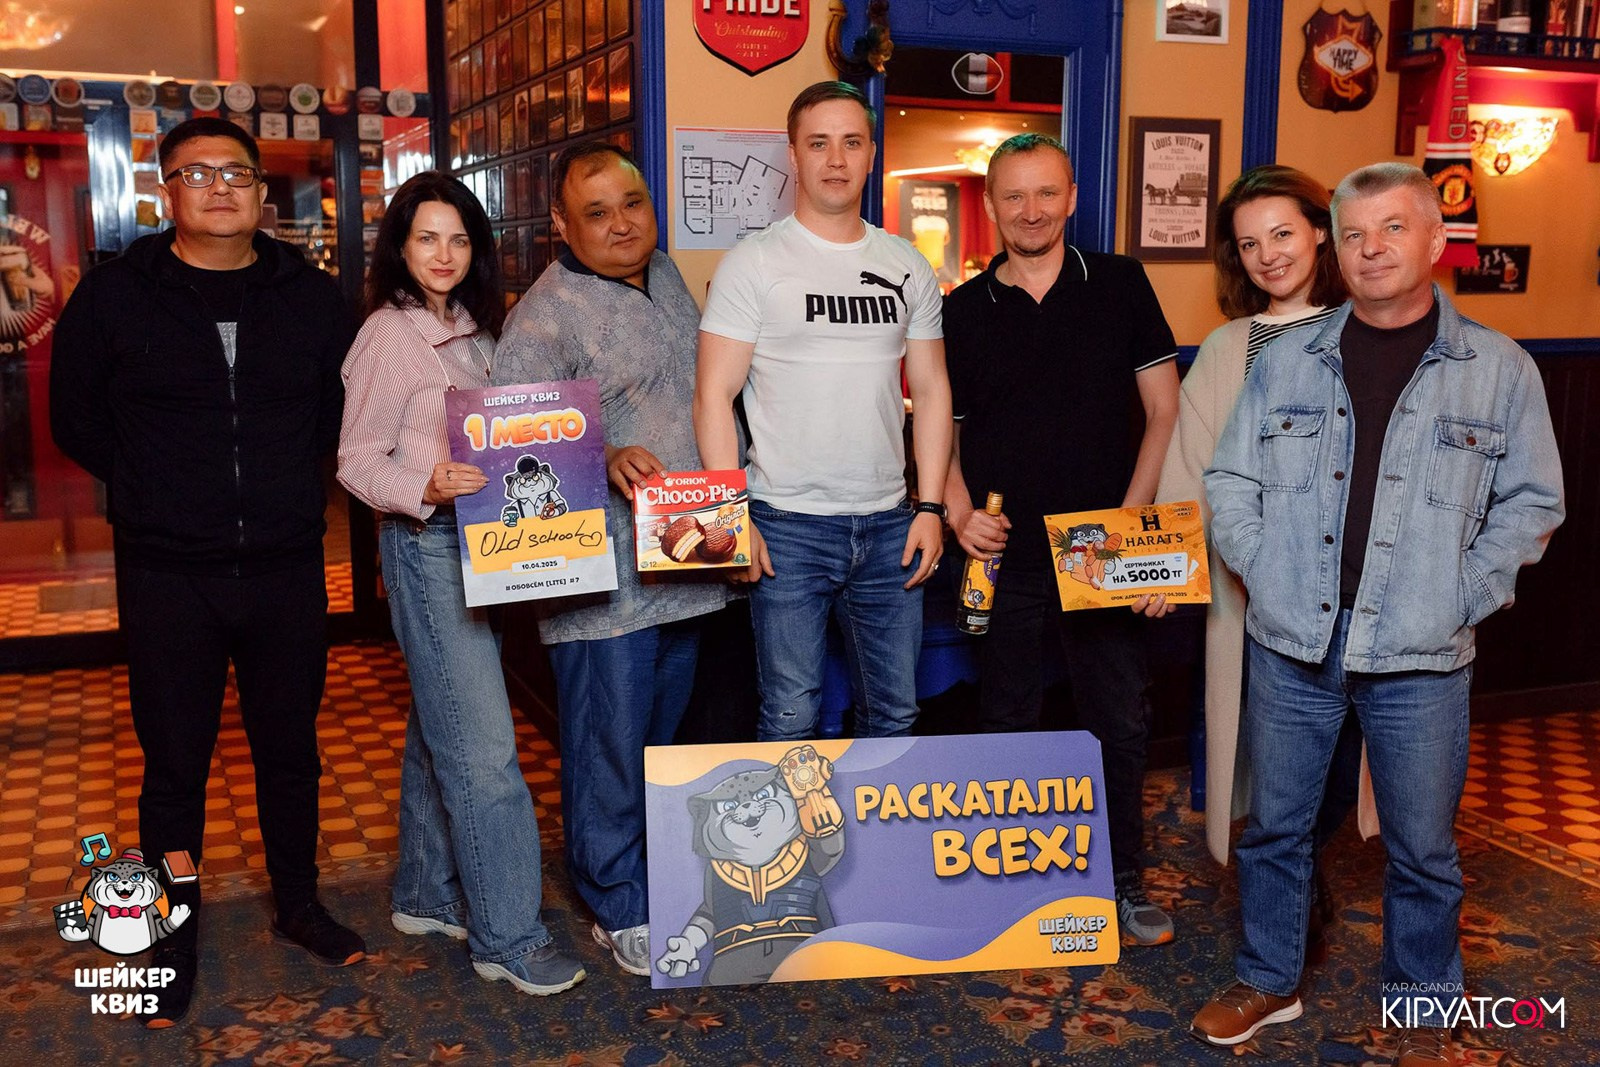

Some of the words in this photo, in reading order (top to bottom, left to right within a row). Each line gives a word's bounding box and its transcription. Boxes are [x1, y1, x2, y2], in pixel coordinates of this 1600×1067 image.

[714, 20, 788, 42] Outstanding
[1151, 136, 1172, 151] LOUIS
[1175, 136, 1205, 152] VUITTON
[1149, 228, 1168, 243] LOUIS
[1171, 229, 1201, 244] VUITTON
[805, 293, 899, 324] PUMA
[484, 394, 527, 407] ШЕЙКЕР
[530, 391, 560, 403] КВИЗ
[465, 414, 486, 450] 1
[490, 408, 586, 449] МЕСТО
[675, 477, 706, 486] ORION
[714, 506, 746, 528] Original
[522, 560, 558, 570] 10.04.2025
[1124, 560, 1165, 569] СЕРТИФИКАТ
[1112, 574, 1127, 584] НА
[1127, 568, 1171, 583] 5000
[1172, 570, 1183, 578] ТГ
[854, 776, 1095, 822] РАСКАТАЛИ
[931, 823, 1092, 878] ВСЕХ!
[1039, 913, 1107, 934] ШЕЙКЕР
[1051, 935, 1097, 953] КВИЗ
